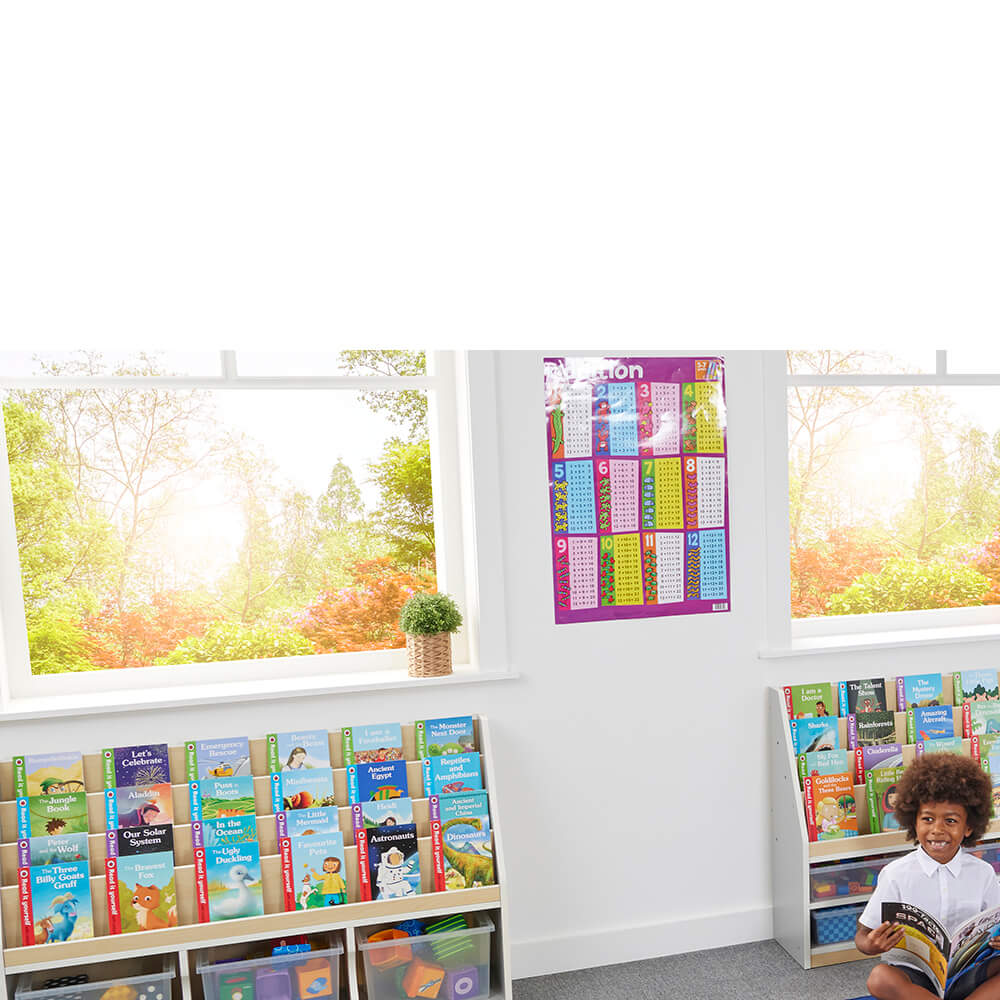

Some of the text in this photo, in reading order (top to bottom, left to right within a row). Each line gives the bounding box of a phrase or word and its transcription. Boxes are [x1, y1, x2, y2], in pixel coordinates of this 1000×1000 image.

[597, 384, 694, 397] 2 3 4
[554, 459, 695, 478] 5 6 7 8
[556, 533, 699, 553] 9 10 11 12
[132, 749, 152, 758] Let's
[122, 758, 163, 767] Celebrate
[816, 776, 849, 784] Goldilocks
[49, 796, 77, 805] Jungle
[47, 805, 70, 813] Book
[123, 828, 167, 839] Our Solar
[216, 828, 243, 836] Ocean
[447, 831, 486, 841] Dinosaurs
[370, 832, 415, 843] Astronauts
[130, 838, 162, 847] System
[57, 844, 79, 853] Wolf
[222, 847, 240, 856] Ugly
[216, 855, 252, 864] Duckling
[36, 873, 84, 884] Billy Goats
[54, 880, 77, 889] Gruff
